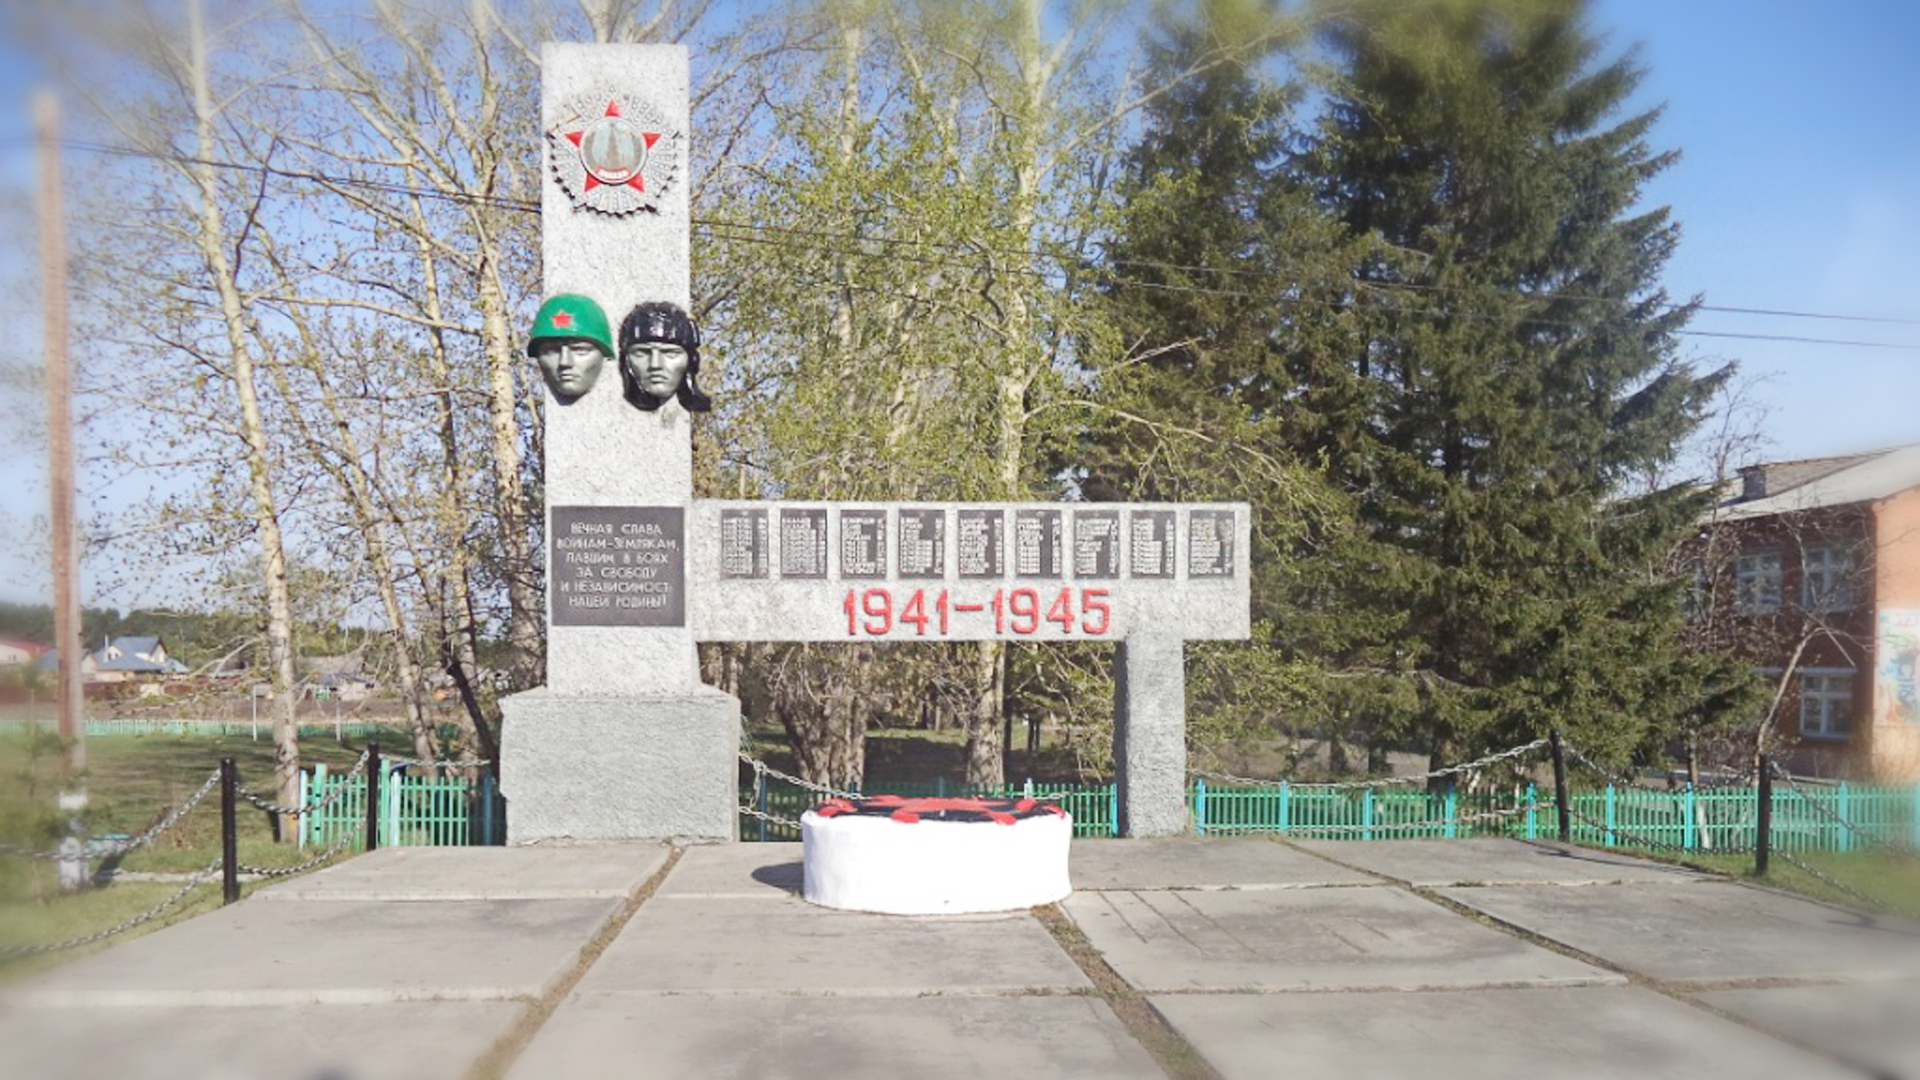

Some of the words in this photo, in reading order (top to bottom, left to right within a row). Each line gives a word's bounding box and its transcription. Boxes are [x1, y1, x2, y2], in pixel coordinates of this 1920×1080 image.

[571, 523, 613, 534] ВЕЧНАЯ
[621, 523, 661, 535] СЛАВА
[576, 567, 593, 577] ЗА
[601, 567, 657, 578] СВОБОДУ
[561, 581, 569, 592] И
[843, 587, 1110, 635] 1941-1945
